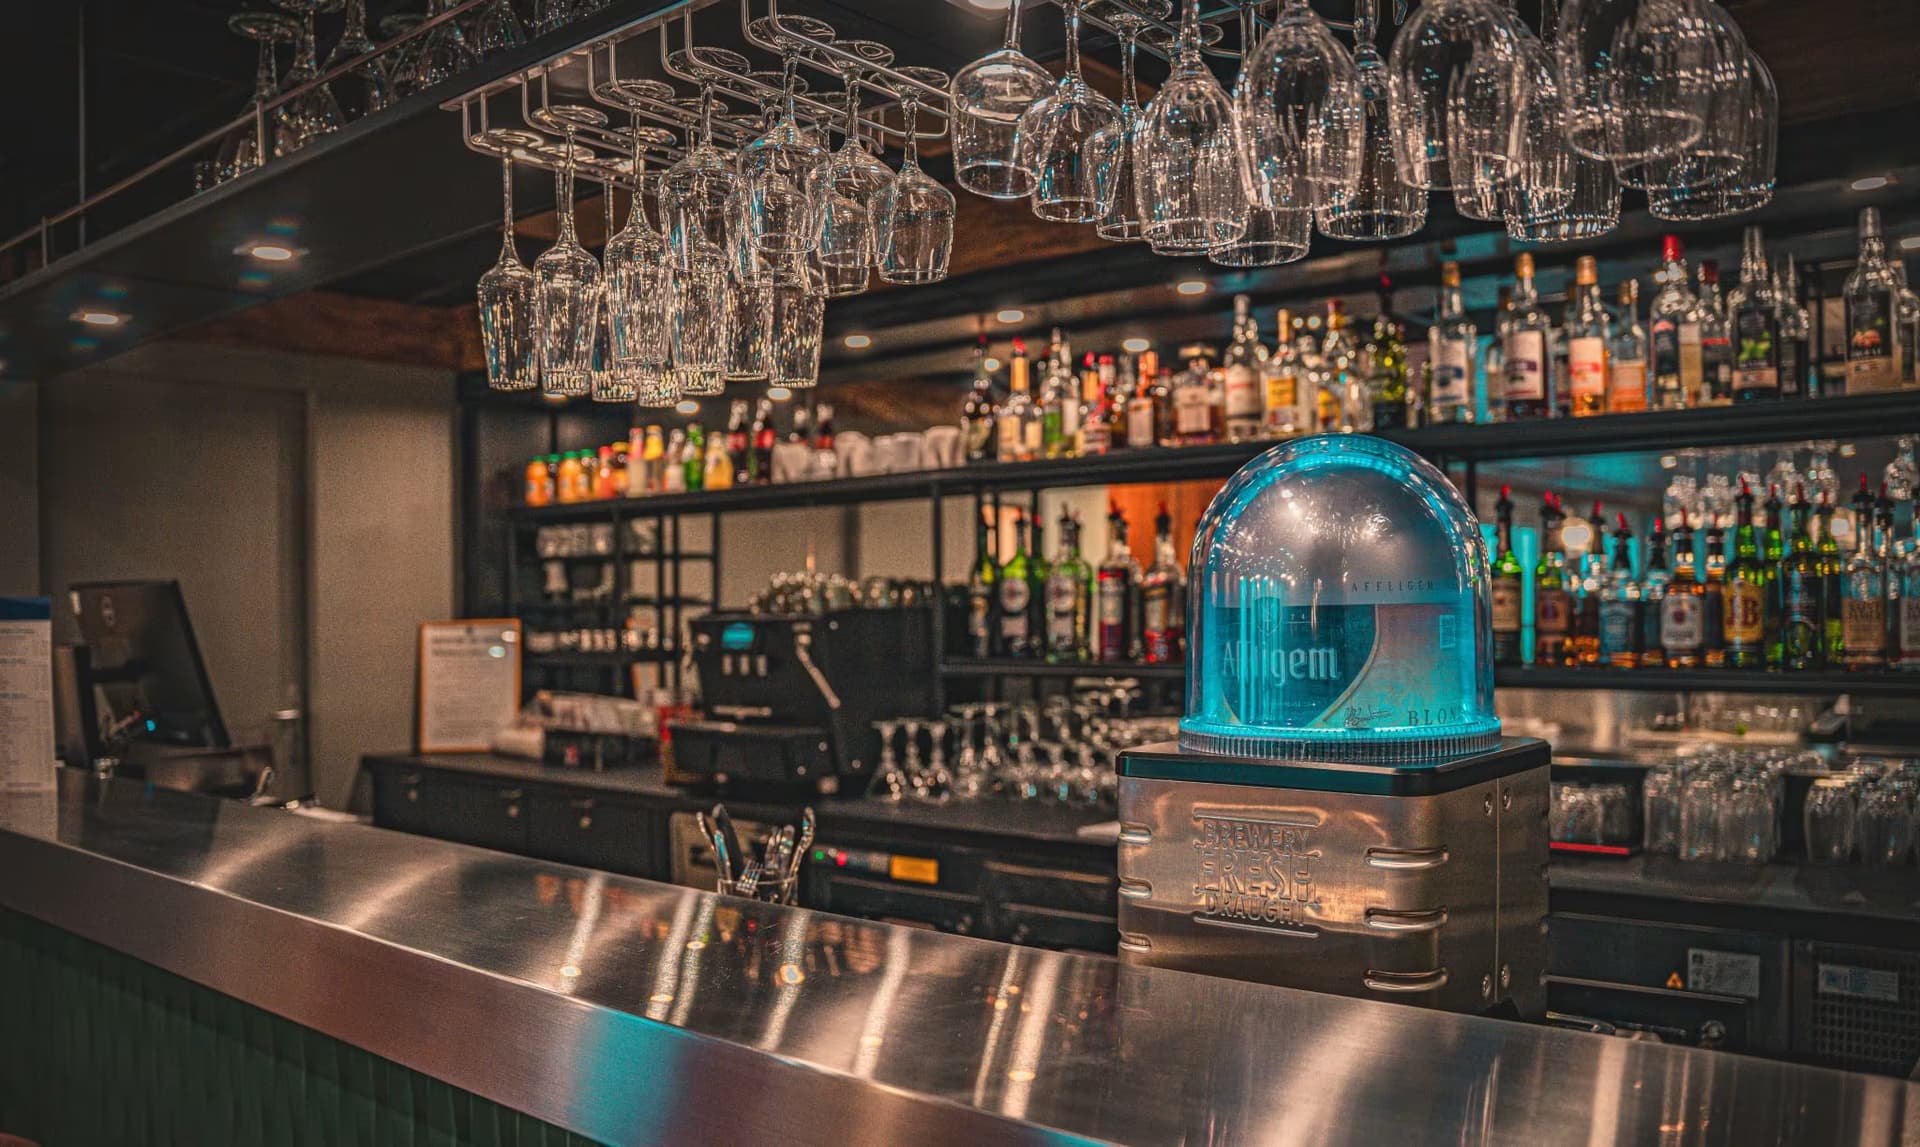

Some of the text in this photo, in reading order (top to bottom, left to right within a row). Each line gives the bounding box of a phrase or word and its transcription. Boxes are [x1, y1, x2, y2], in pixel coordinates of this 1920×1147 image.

[1408, 703, 1462, 726] BLON
[1203, 821, 1309, 854] BREWERY
[1198, 848, 1319, 902] FRESH
[1205, 893, 1307, 926] DRAUGHT
